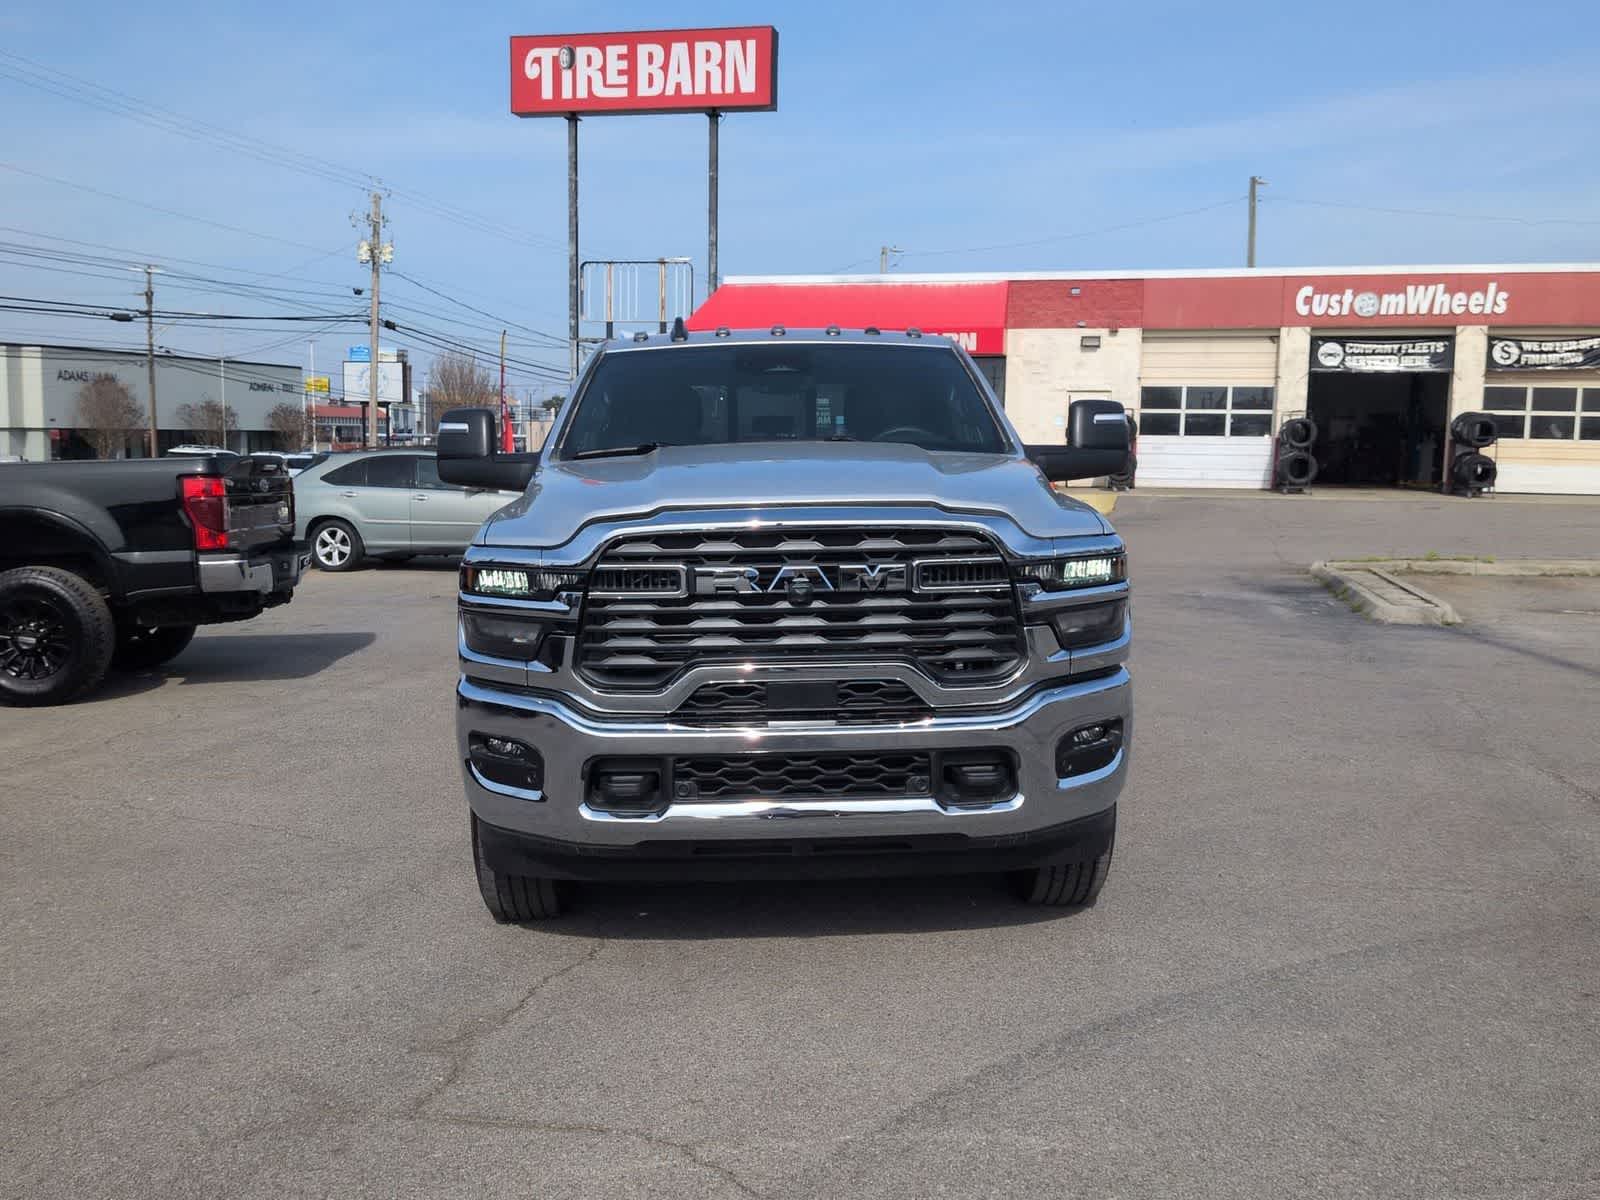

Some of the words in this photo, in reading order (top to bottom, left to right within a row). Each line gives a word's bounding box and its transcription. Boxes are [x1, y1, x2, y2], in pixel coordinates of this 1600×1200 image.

[637, 39, 757, 97] BARN
[1345, 342, 1401, 354] COMPANY
[1401, 341, 1445, 353] FLEETS
[1521, 341, 1541, 351] WE
[57, 369, 89, 382] ADAMS
[694, 565, 907, 593] RAM
